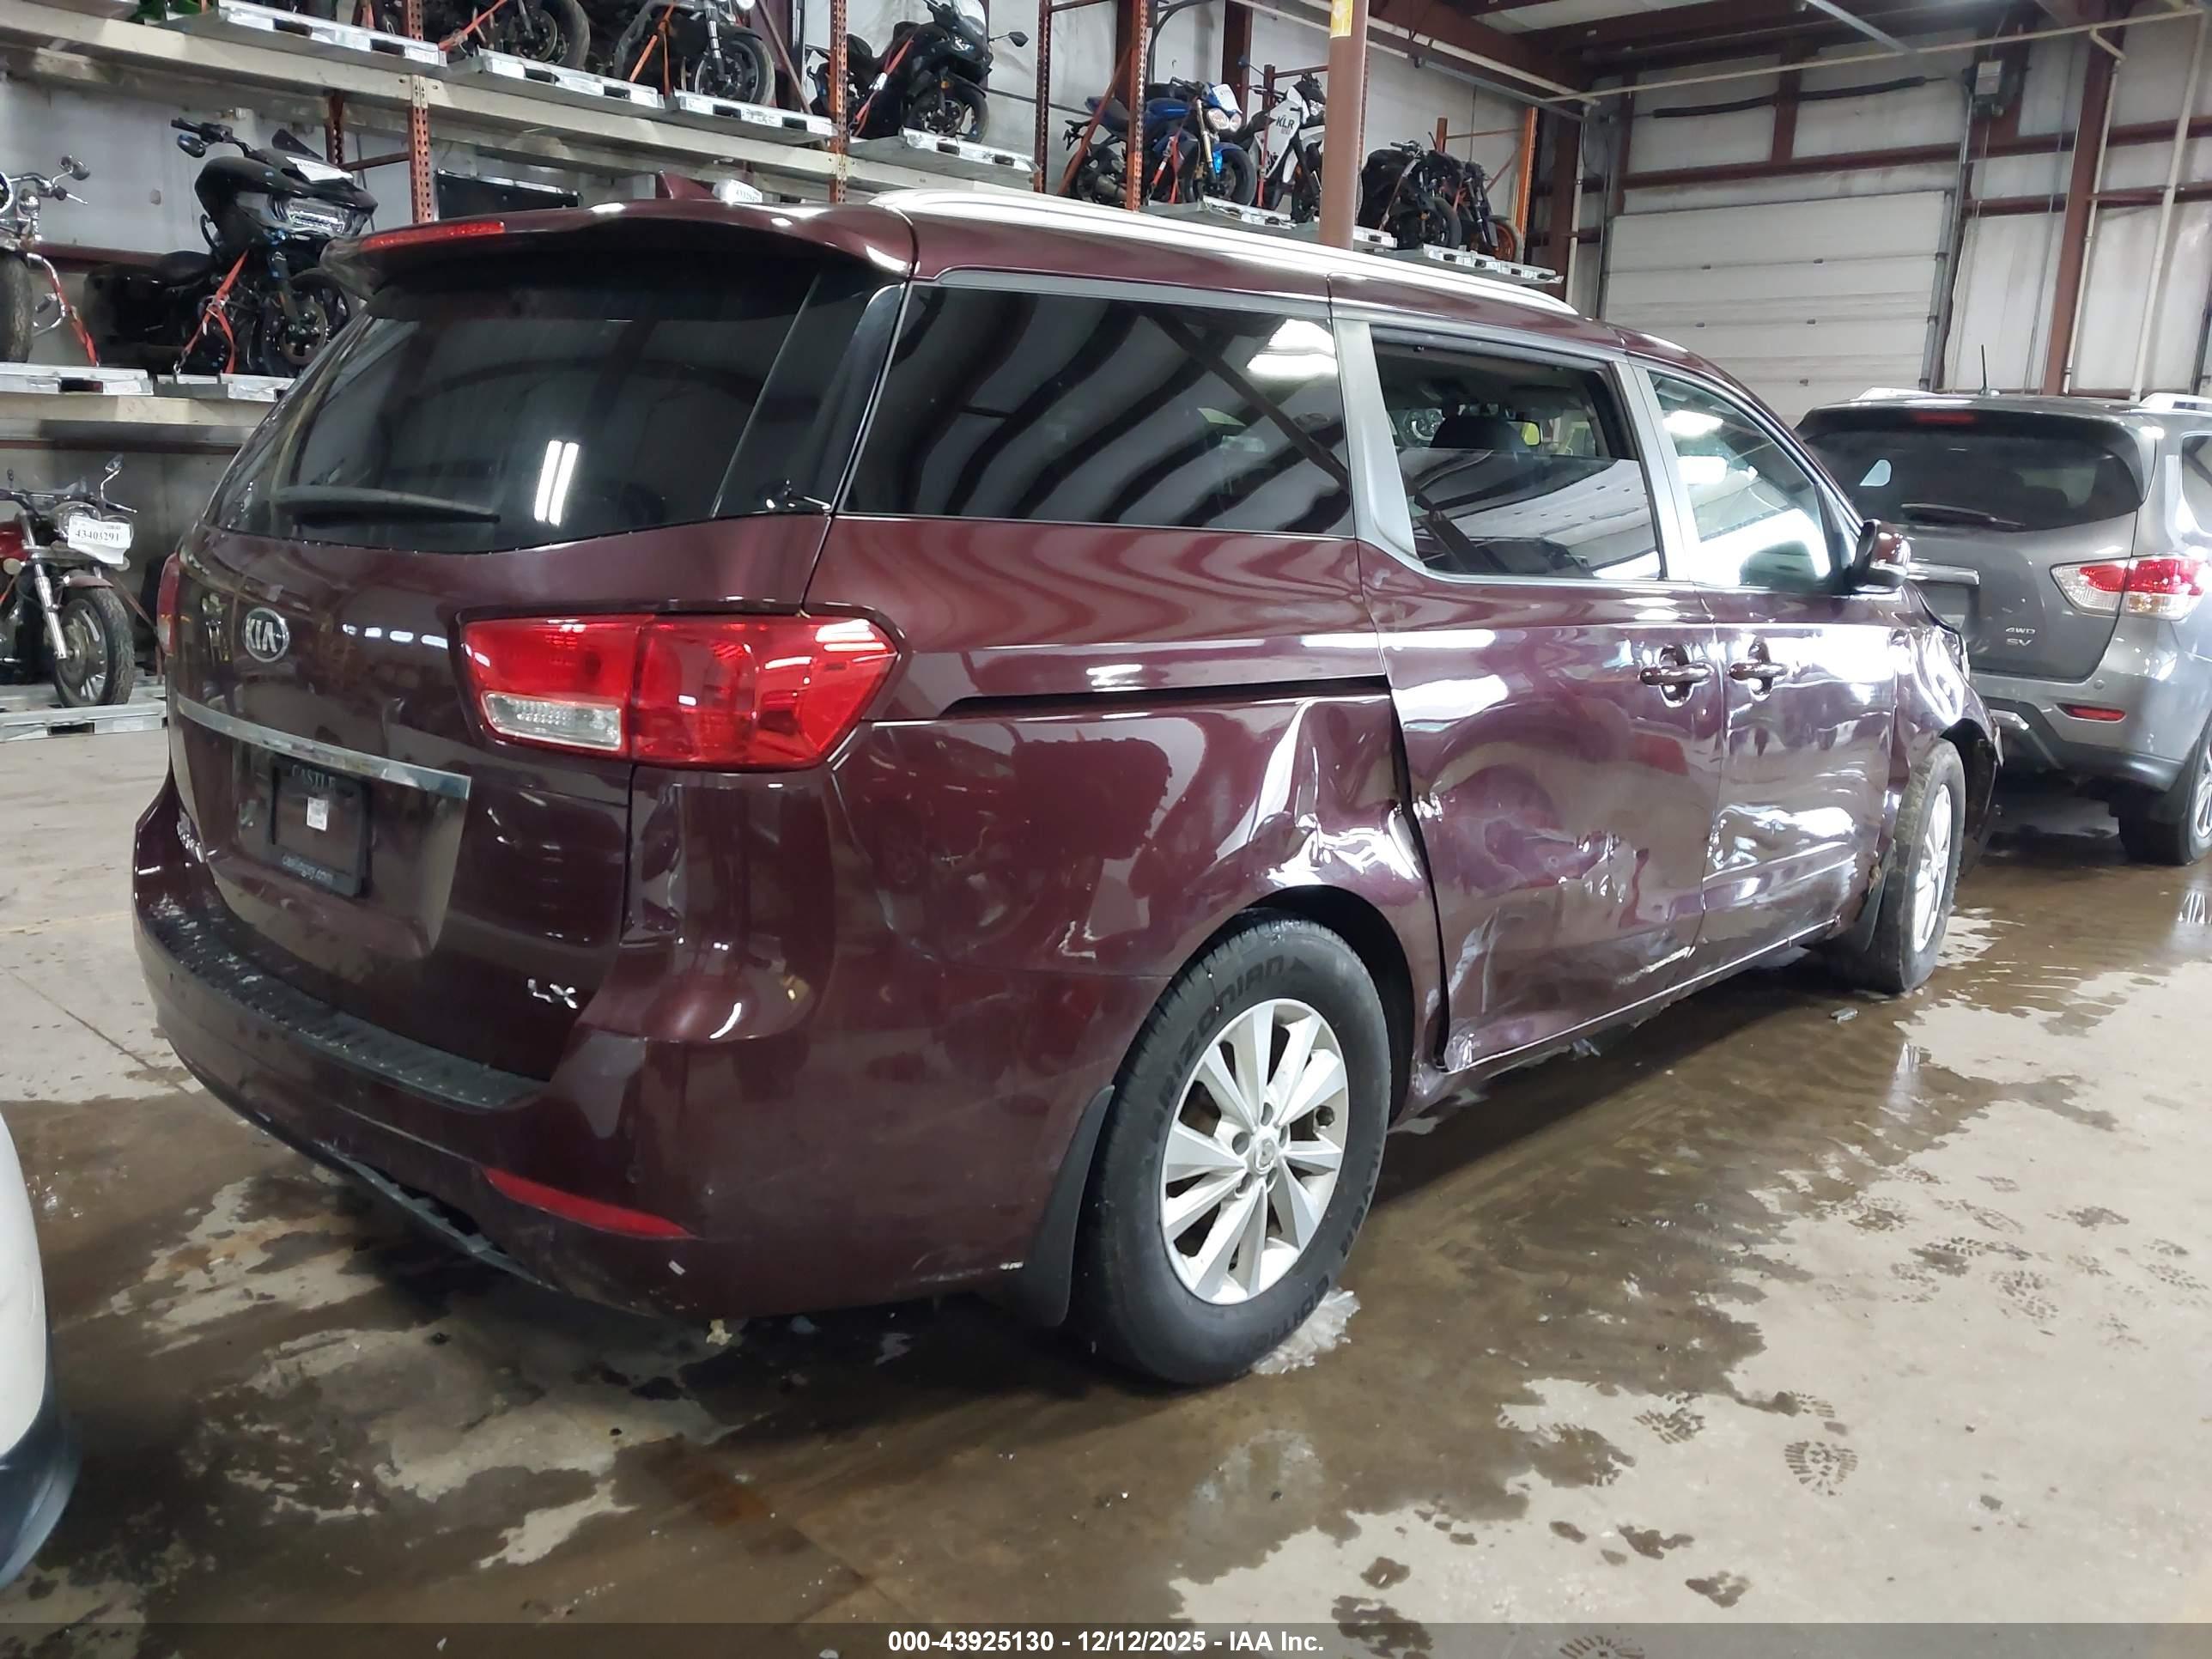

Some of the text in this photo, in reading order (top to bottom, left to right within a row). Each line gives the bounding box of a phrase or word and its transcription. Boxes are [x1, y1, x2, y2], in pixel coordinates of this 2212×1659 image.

[1276, 116, 1295, 130] KLR
[246, 617, 278, 653] KIA
[2006, 638, 2033, 647] SV
[527, 978, 579, 1009] LX
